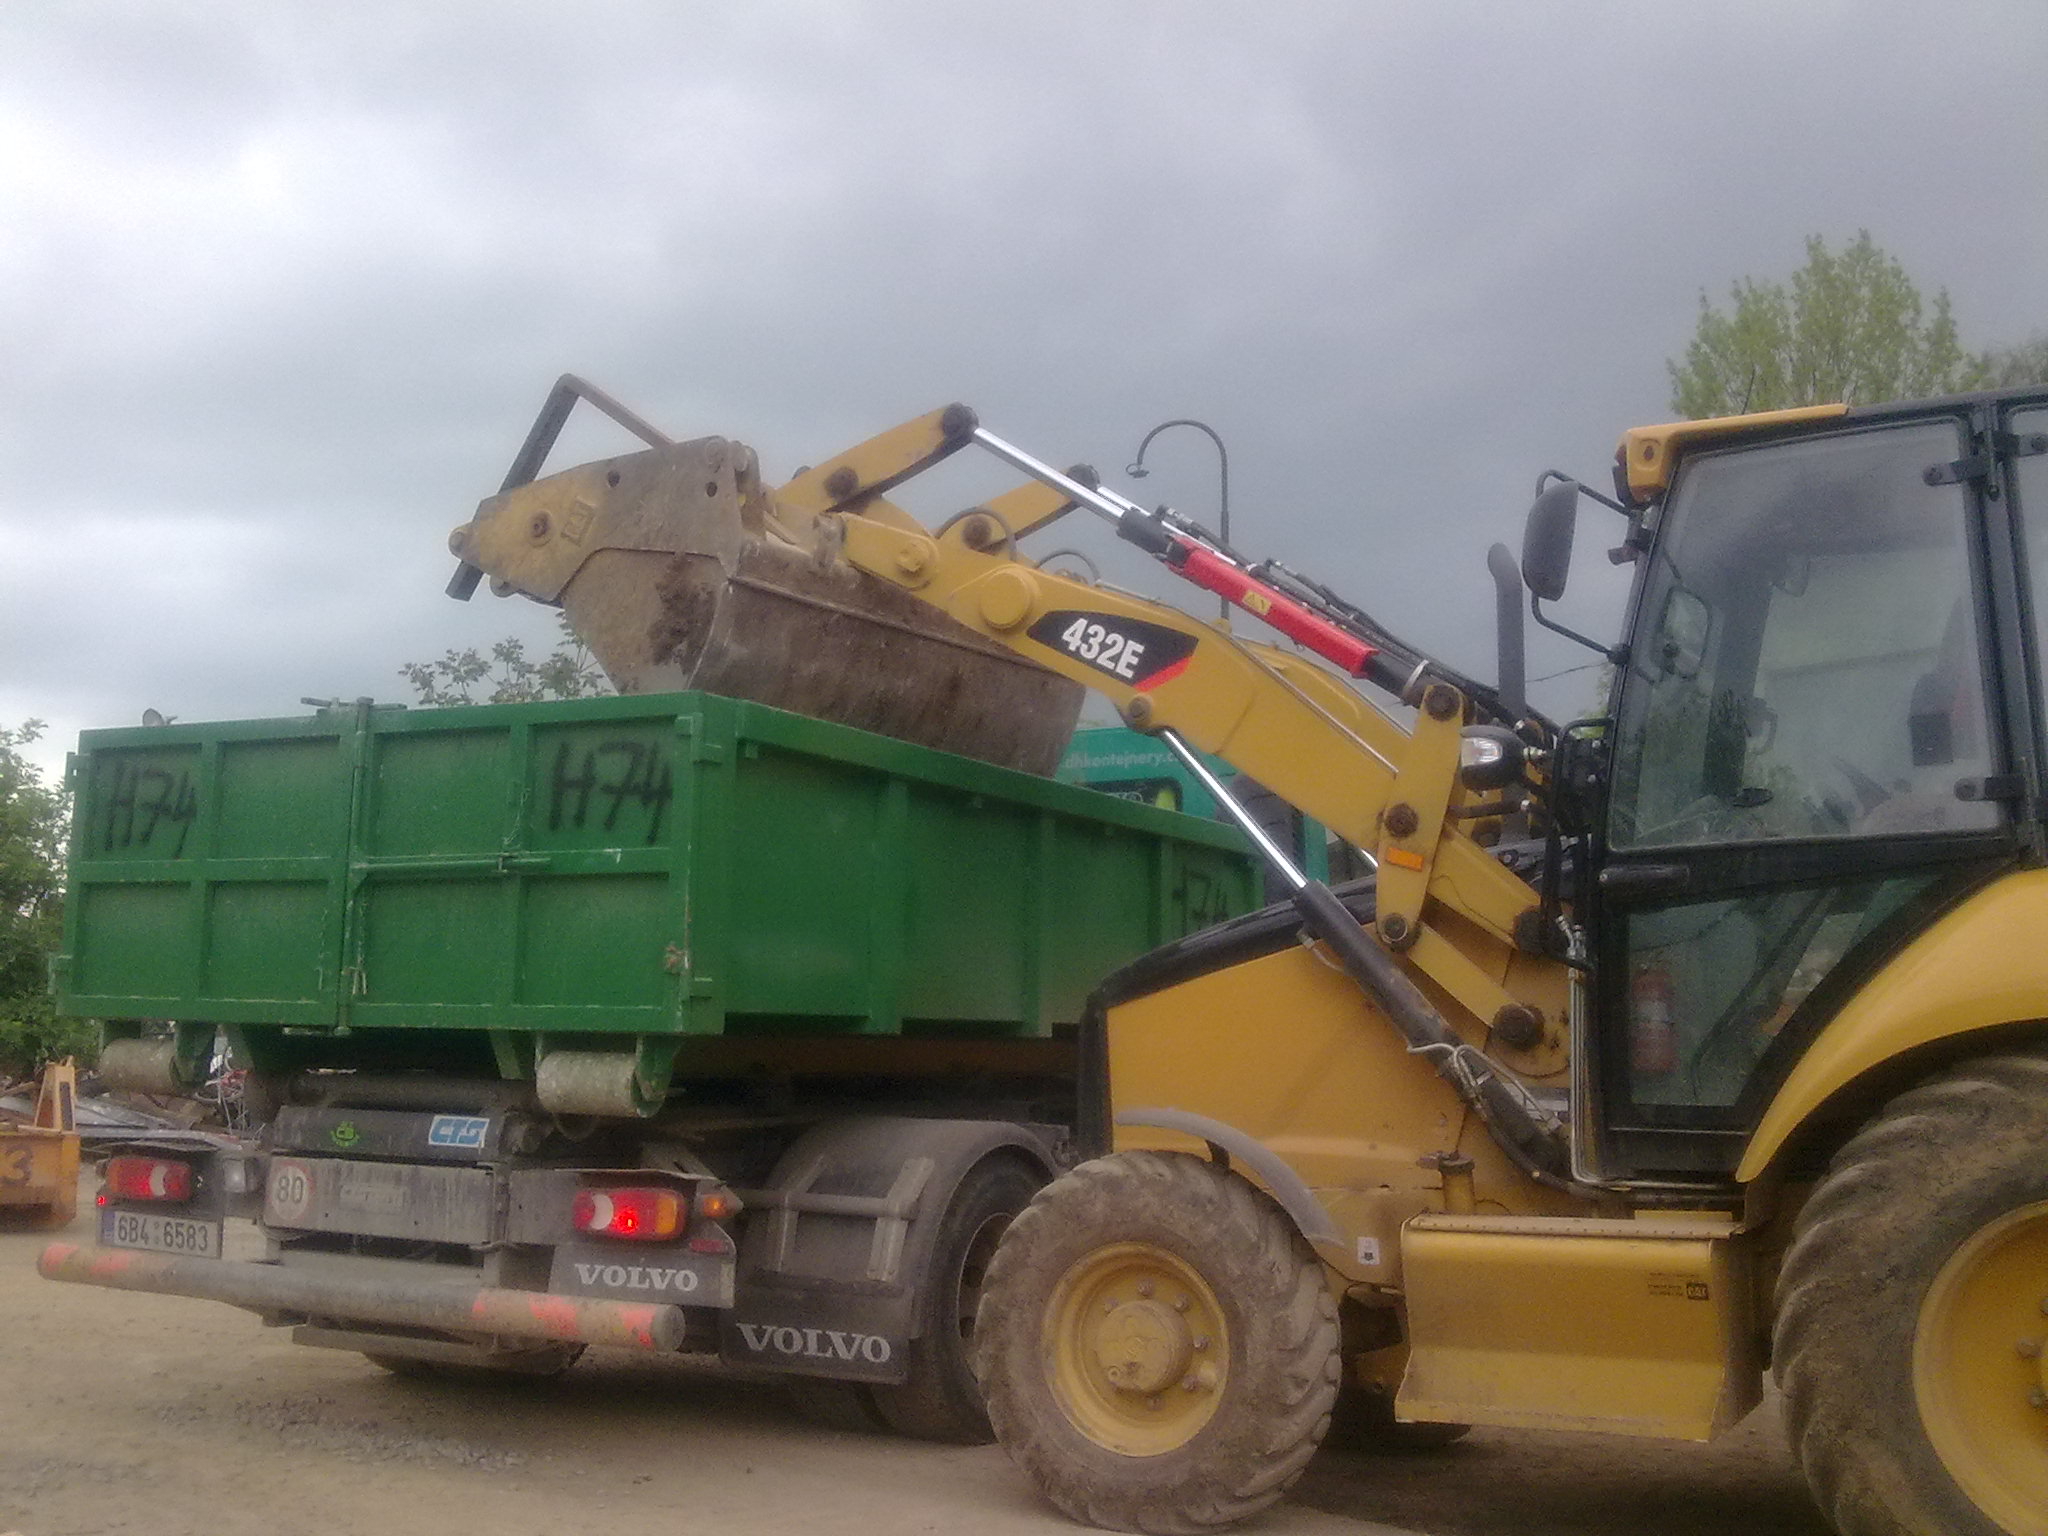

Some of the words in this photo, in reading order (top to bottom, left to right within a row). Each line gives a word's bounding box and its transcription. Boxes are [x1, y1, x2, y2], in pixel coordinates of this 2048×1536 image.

[1062, 618, 1145, 678] 432E
[104, 759, 197, 859] H74
[549, 741, 672, 844] H74
[277, 1175, 304, 1204] 80
[118, 1216, 150, 1245] 6B4
[163, 1221, 208, 1251] 6583
[575, 1264, 698, 1291] VOLVO
[736, 1323, 891, 1362] VOLVO
